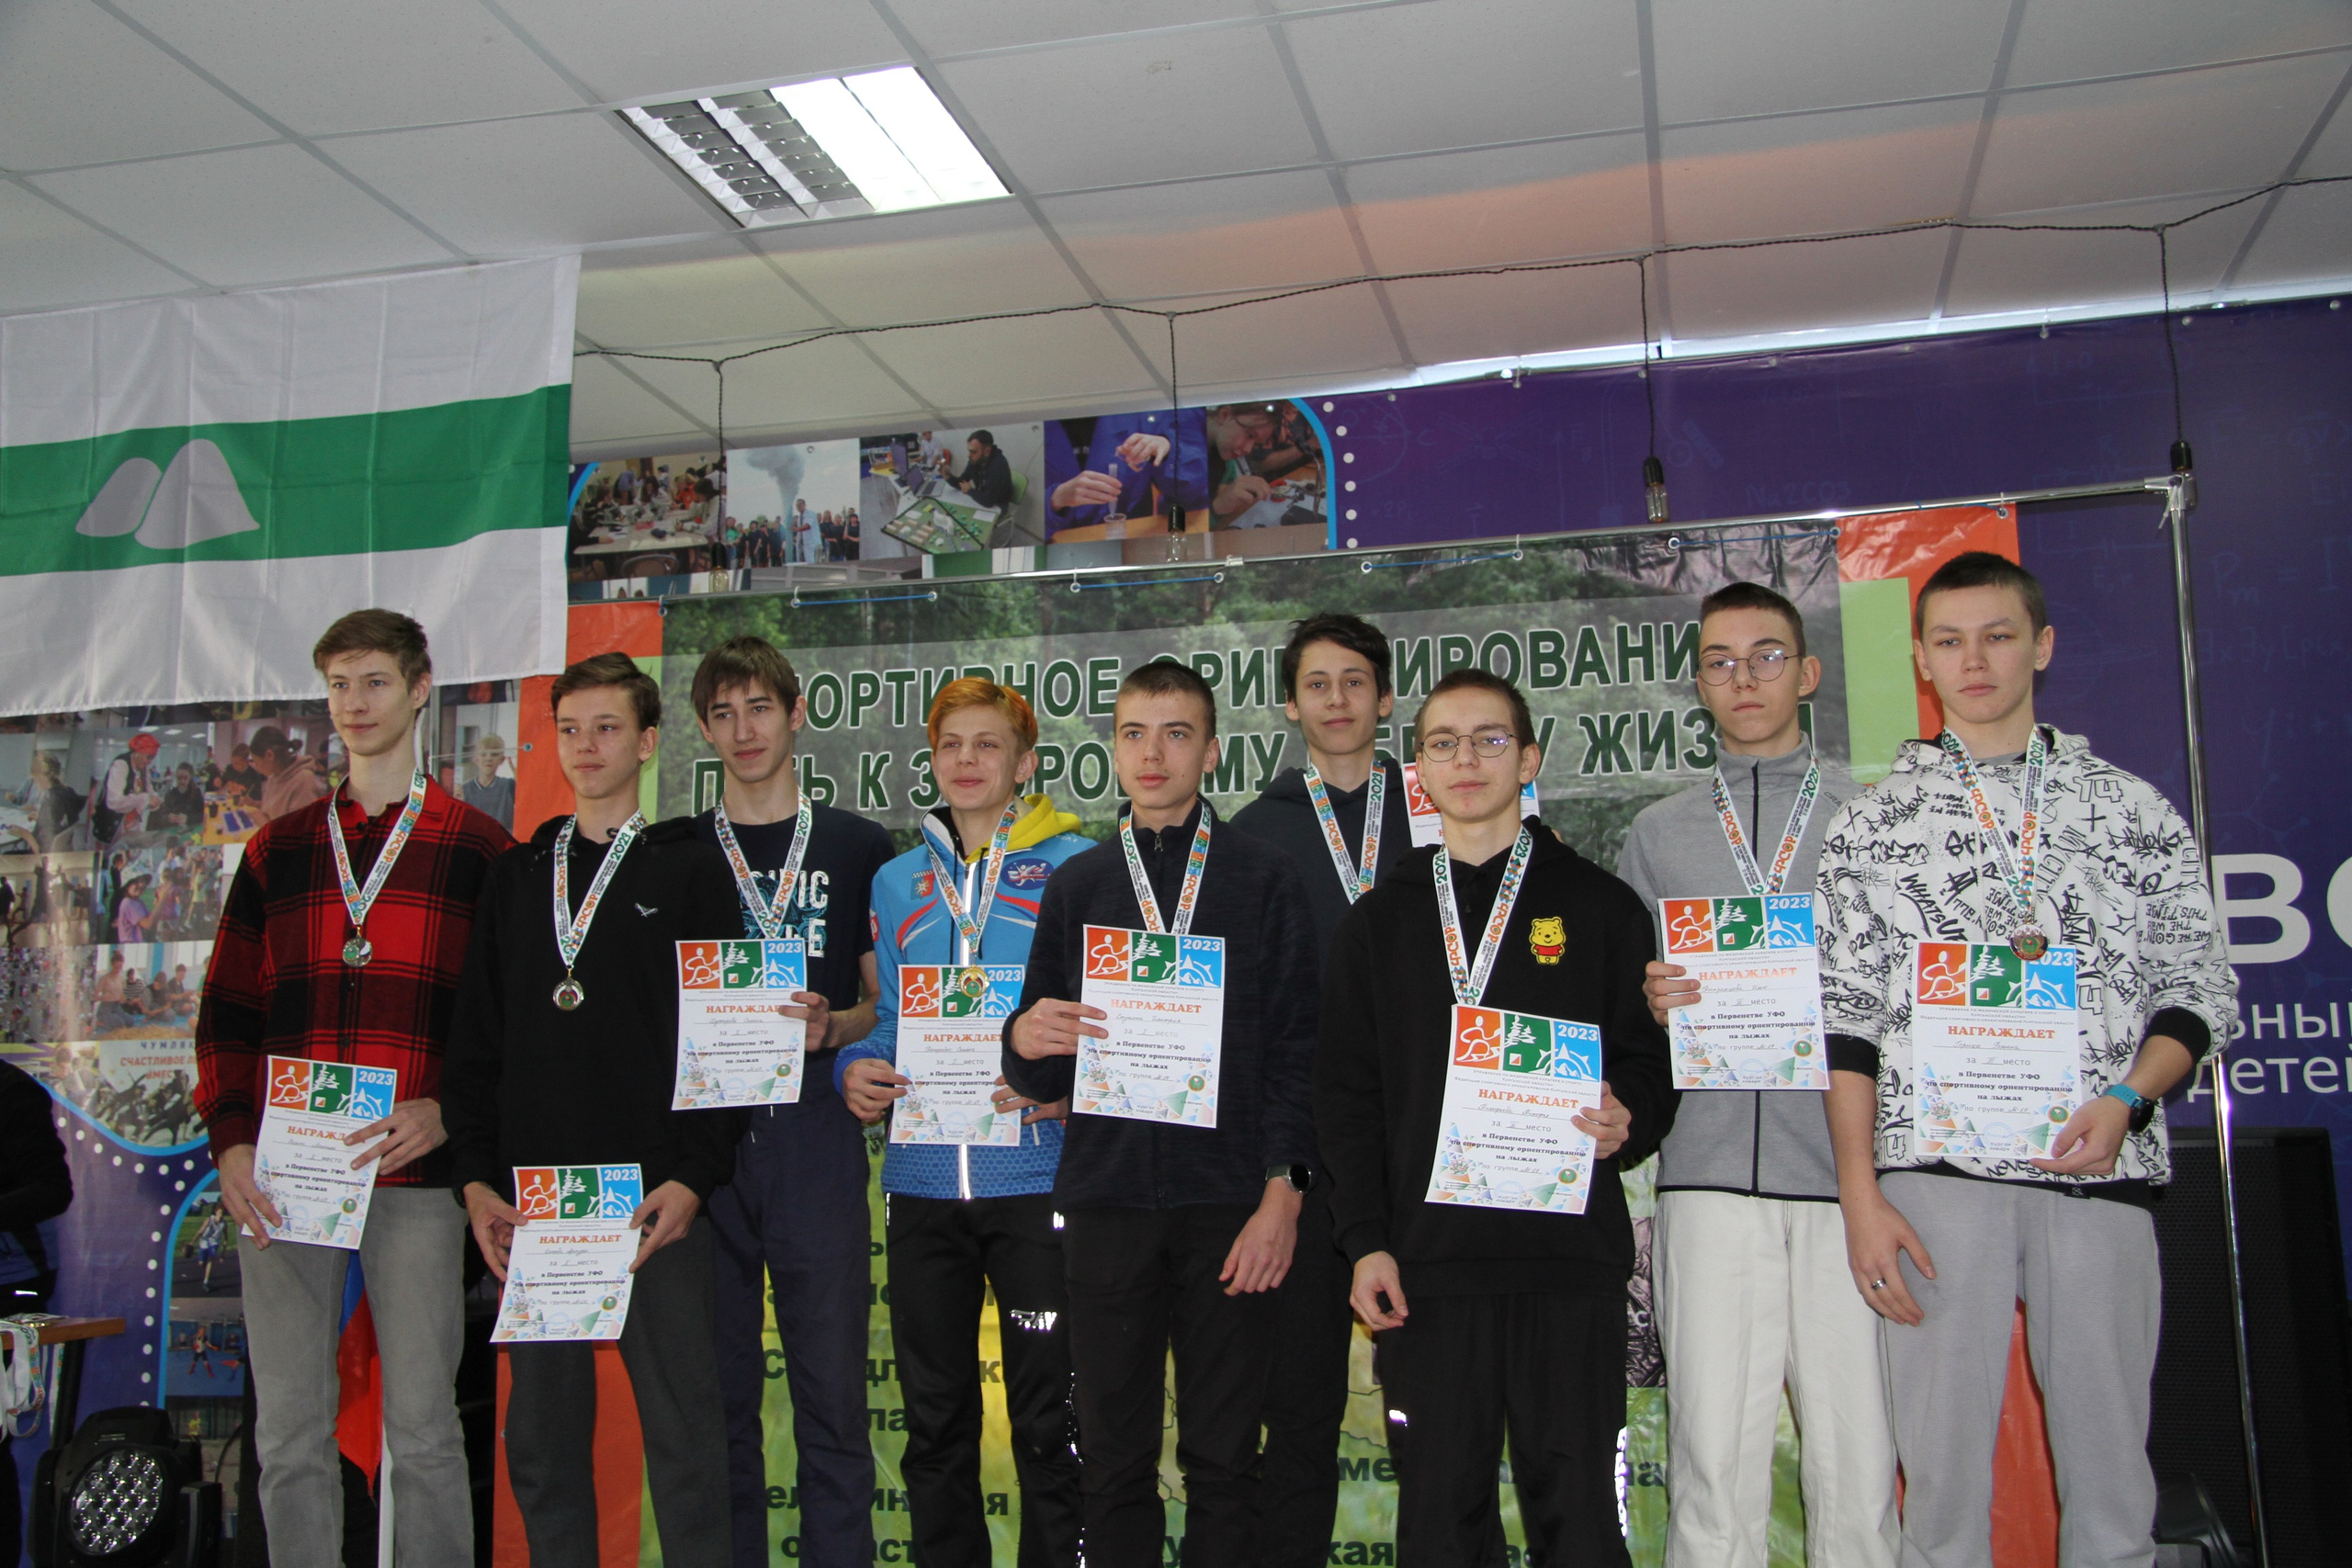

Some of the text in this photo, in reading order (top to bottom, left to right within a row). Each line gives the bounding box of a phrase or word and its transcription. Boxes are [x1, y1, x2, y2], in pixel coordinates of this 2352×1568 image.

[795, 620, 1702, 731] ОРТИНОЕ РИИРОВАНИ
[692, 753, 837, 818] ПЬ
[857, 751, 892, 810] К
[908, 732, 1288, 812] ЗРОМУ
[1578, 701, 1814, 777] ЖИЗ
[2029, 740, 2045, 766] 2023
[1371, 773, 1384, 802] 2023
[1802, 768, 1819, 798] 2023
[797, 809, 812, 837] 2023
[610, 832, 631, 861] 2023
[1123, 830, 1138, 865] 2023
[1769, 897, 1810, 910] 2023
[2169, 919, 2192, 931] THE
[767, 942, 802, 953] 2023
[1182, 938, 1221, 952] 2023
[988, 969, 1022, 982] 2023
[1699, 967, 1797, 981] НАГРАЖДАЕТ
[706, 1004, 780, 1013] НАГРАЖДАЕ
[1111, 998, 1202, 1013] НАГРАЖДАЕТ
[1717, 1012, 1763, 1021] Первенстве
[1747, 1021, 1815, 1030] ориентированию
[1948, 1025, 2055, 1039] НАГРАЖДАЕТ
[1557, 1024, 1599, 1042] 2023
[1123, 1040, 1166, 1049] Первенстве
[119, 1055, 185, 1066] СЧАСТЛИВОЕ
[358, 1070, 394, 1086] 2023
[1966, 1071, 2016, 1079] Первенстве
[2188, 1055, 2352, 1102] дете
[1939, 1081, 1996, 1090] спортивному
[1997, 1084, 2073, 1092] ориентированию
[1478, 1089, 1579, 1109] НАГРАЖДАЕТ
[287, 1125, 347, 1142] НАГРАЖД
[1525, 1123, 1552, 1133] место
[1488, 1133, 1535, 1143] Первенстве
[1463, 1141, 1515, 1152] спортивному
[1516, 1146, 1587, 1157] ориентированию
[604, 1168, 639, 1181] 2023
[539, 1235, 622, 1244] НАГРАЖДАЕТ
